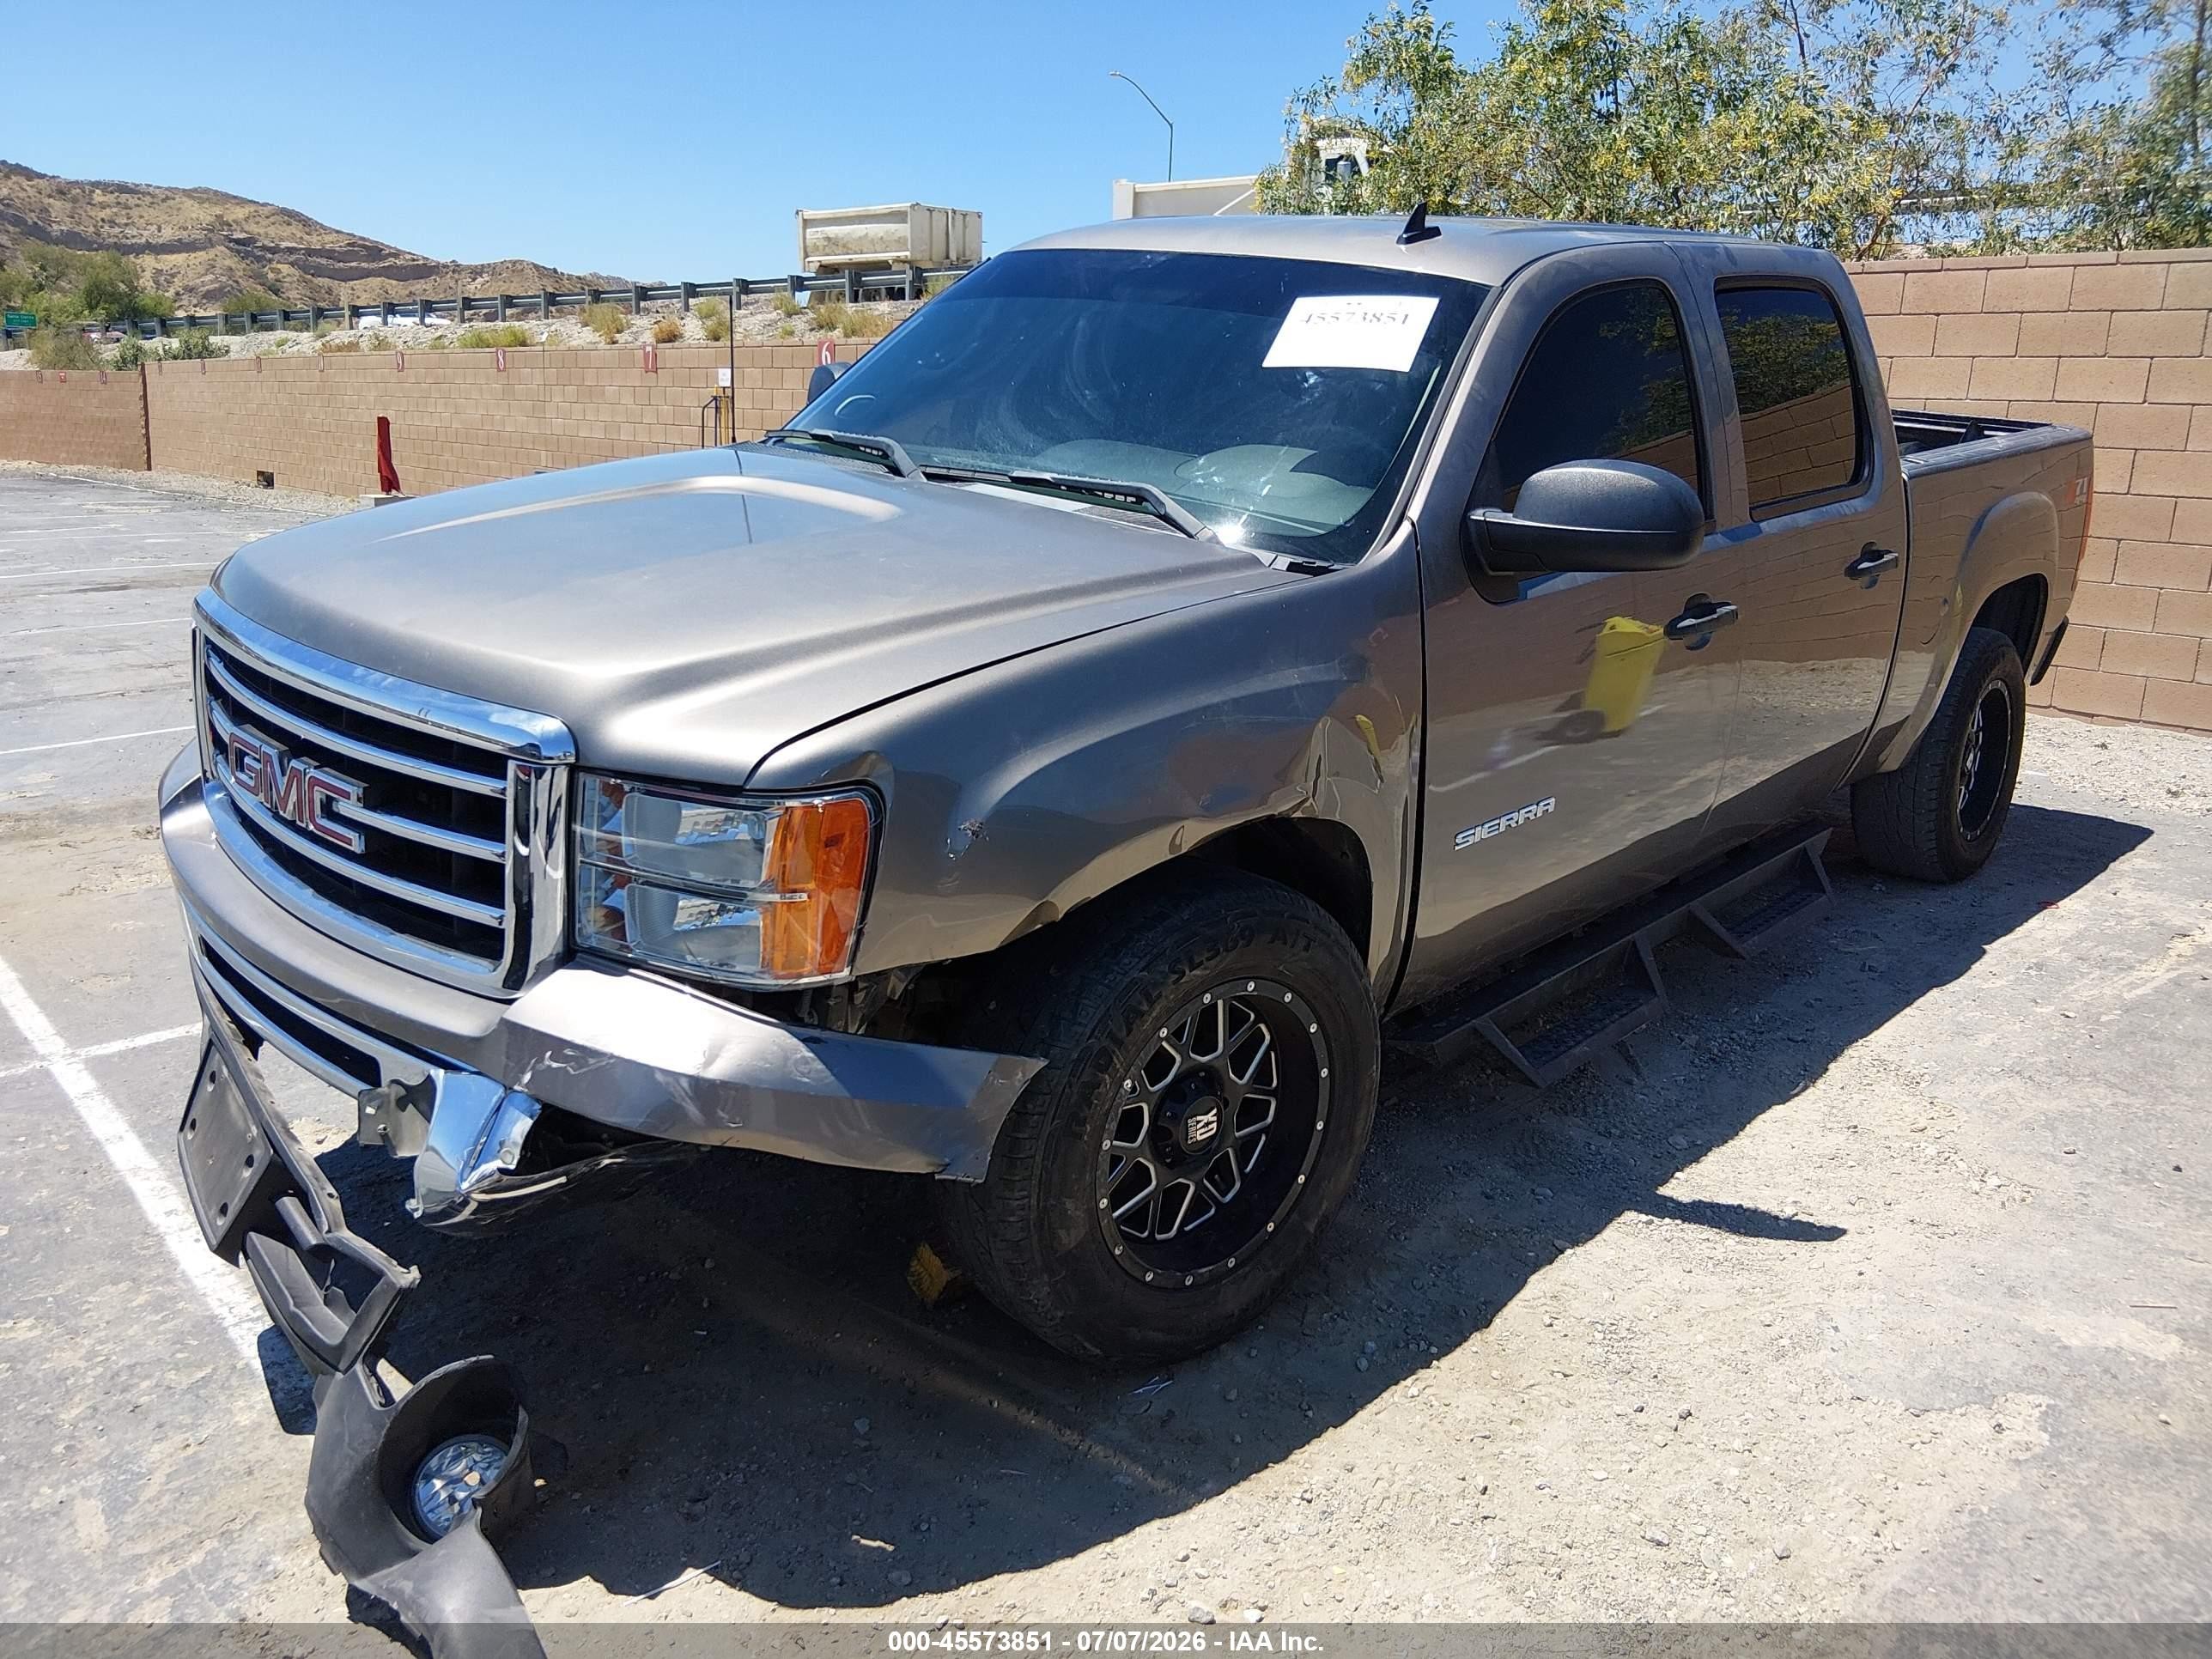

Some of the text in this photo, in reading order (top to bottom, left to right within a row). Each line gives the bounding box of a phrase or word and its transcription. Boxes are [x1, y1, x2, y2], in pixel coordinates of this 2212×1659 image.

[498, 349, 504, 370] 8
[821, 342, 831, 365] 6
[228, 730, 366, 854] GMC
[1454, 796, 1556, 851] SIERRA
[1187, 1117, 1197, 1144] SERIES
[1196, 1108, 1218, 1141] XD
